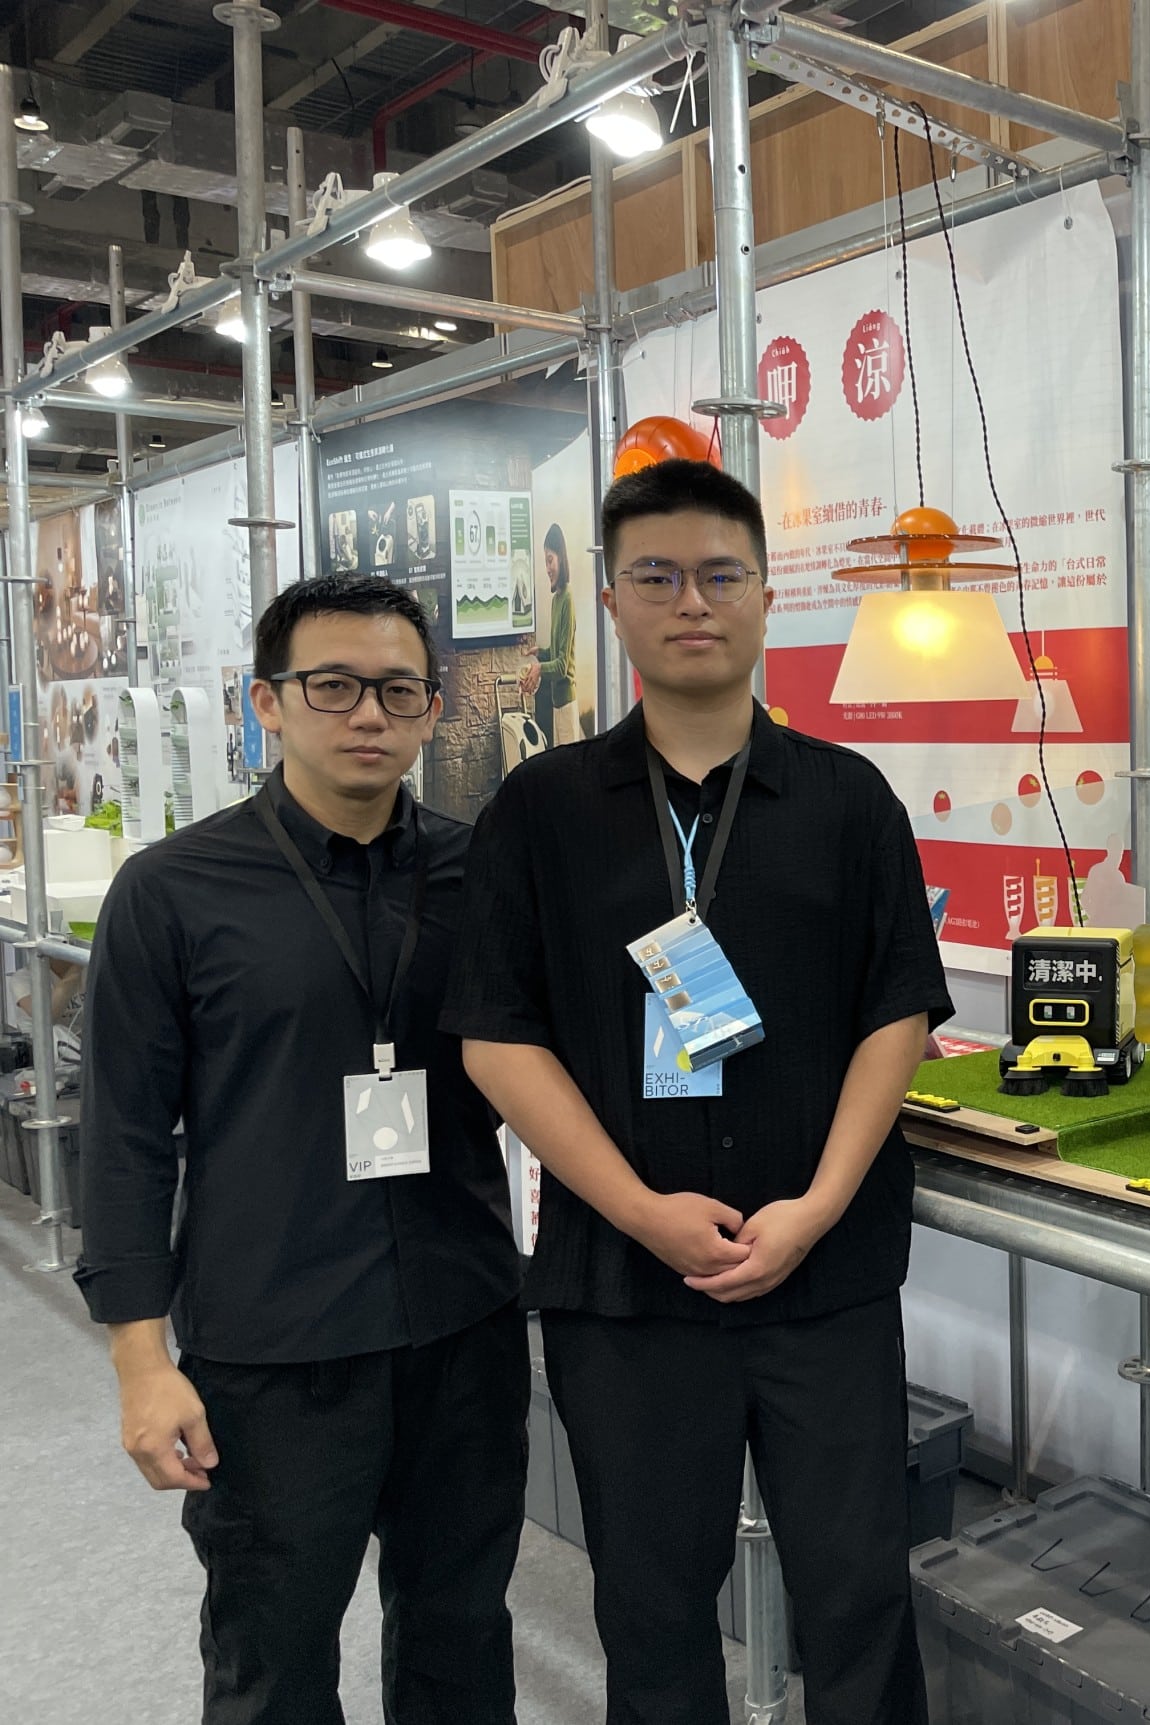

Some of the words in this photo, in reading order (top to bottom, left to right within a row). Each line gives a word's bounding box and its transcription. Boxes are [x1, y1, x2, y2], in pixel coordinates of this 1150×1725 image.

[645, 1072, 686, 1085] EXHI-
[645, 1084, 689, 1097] BITOR
[348, 1160, 372, 1173] VIP
